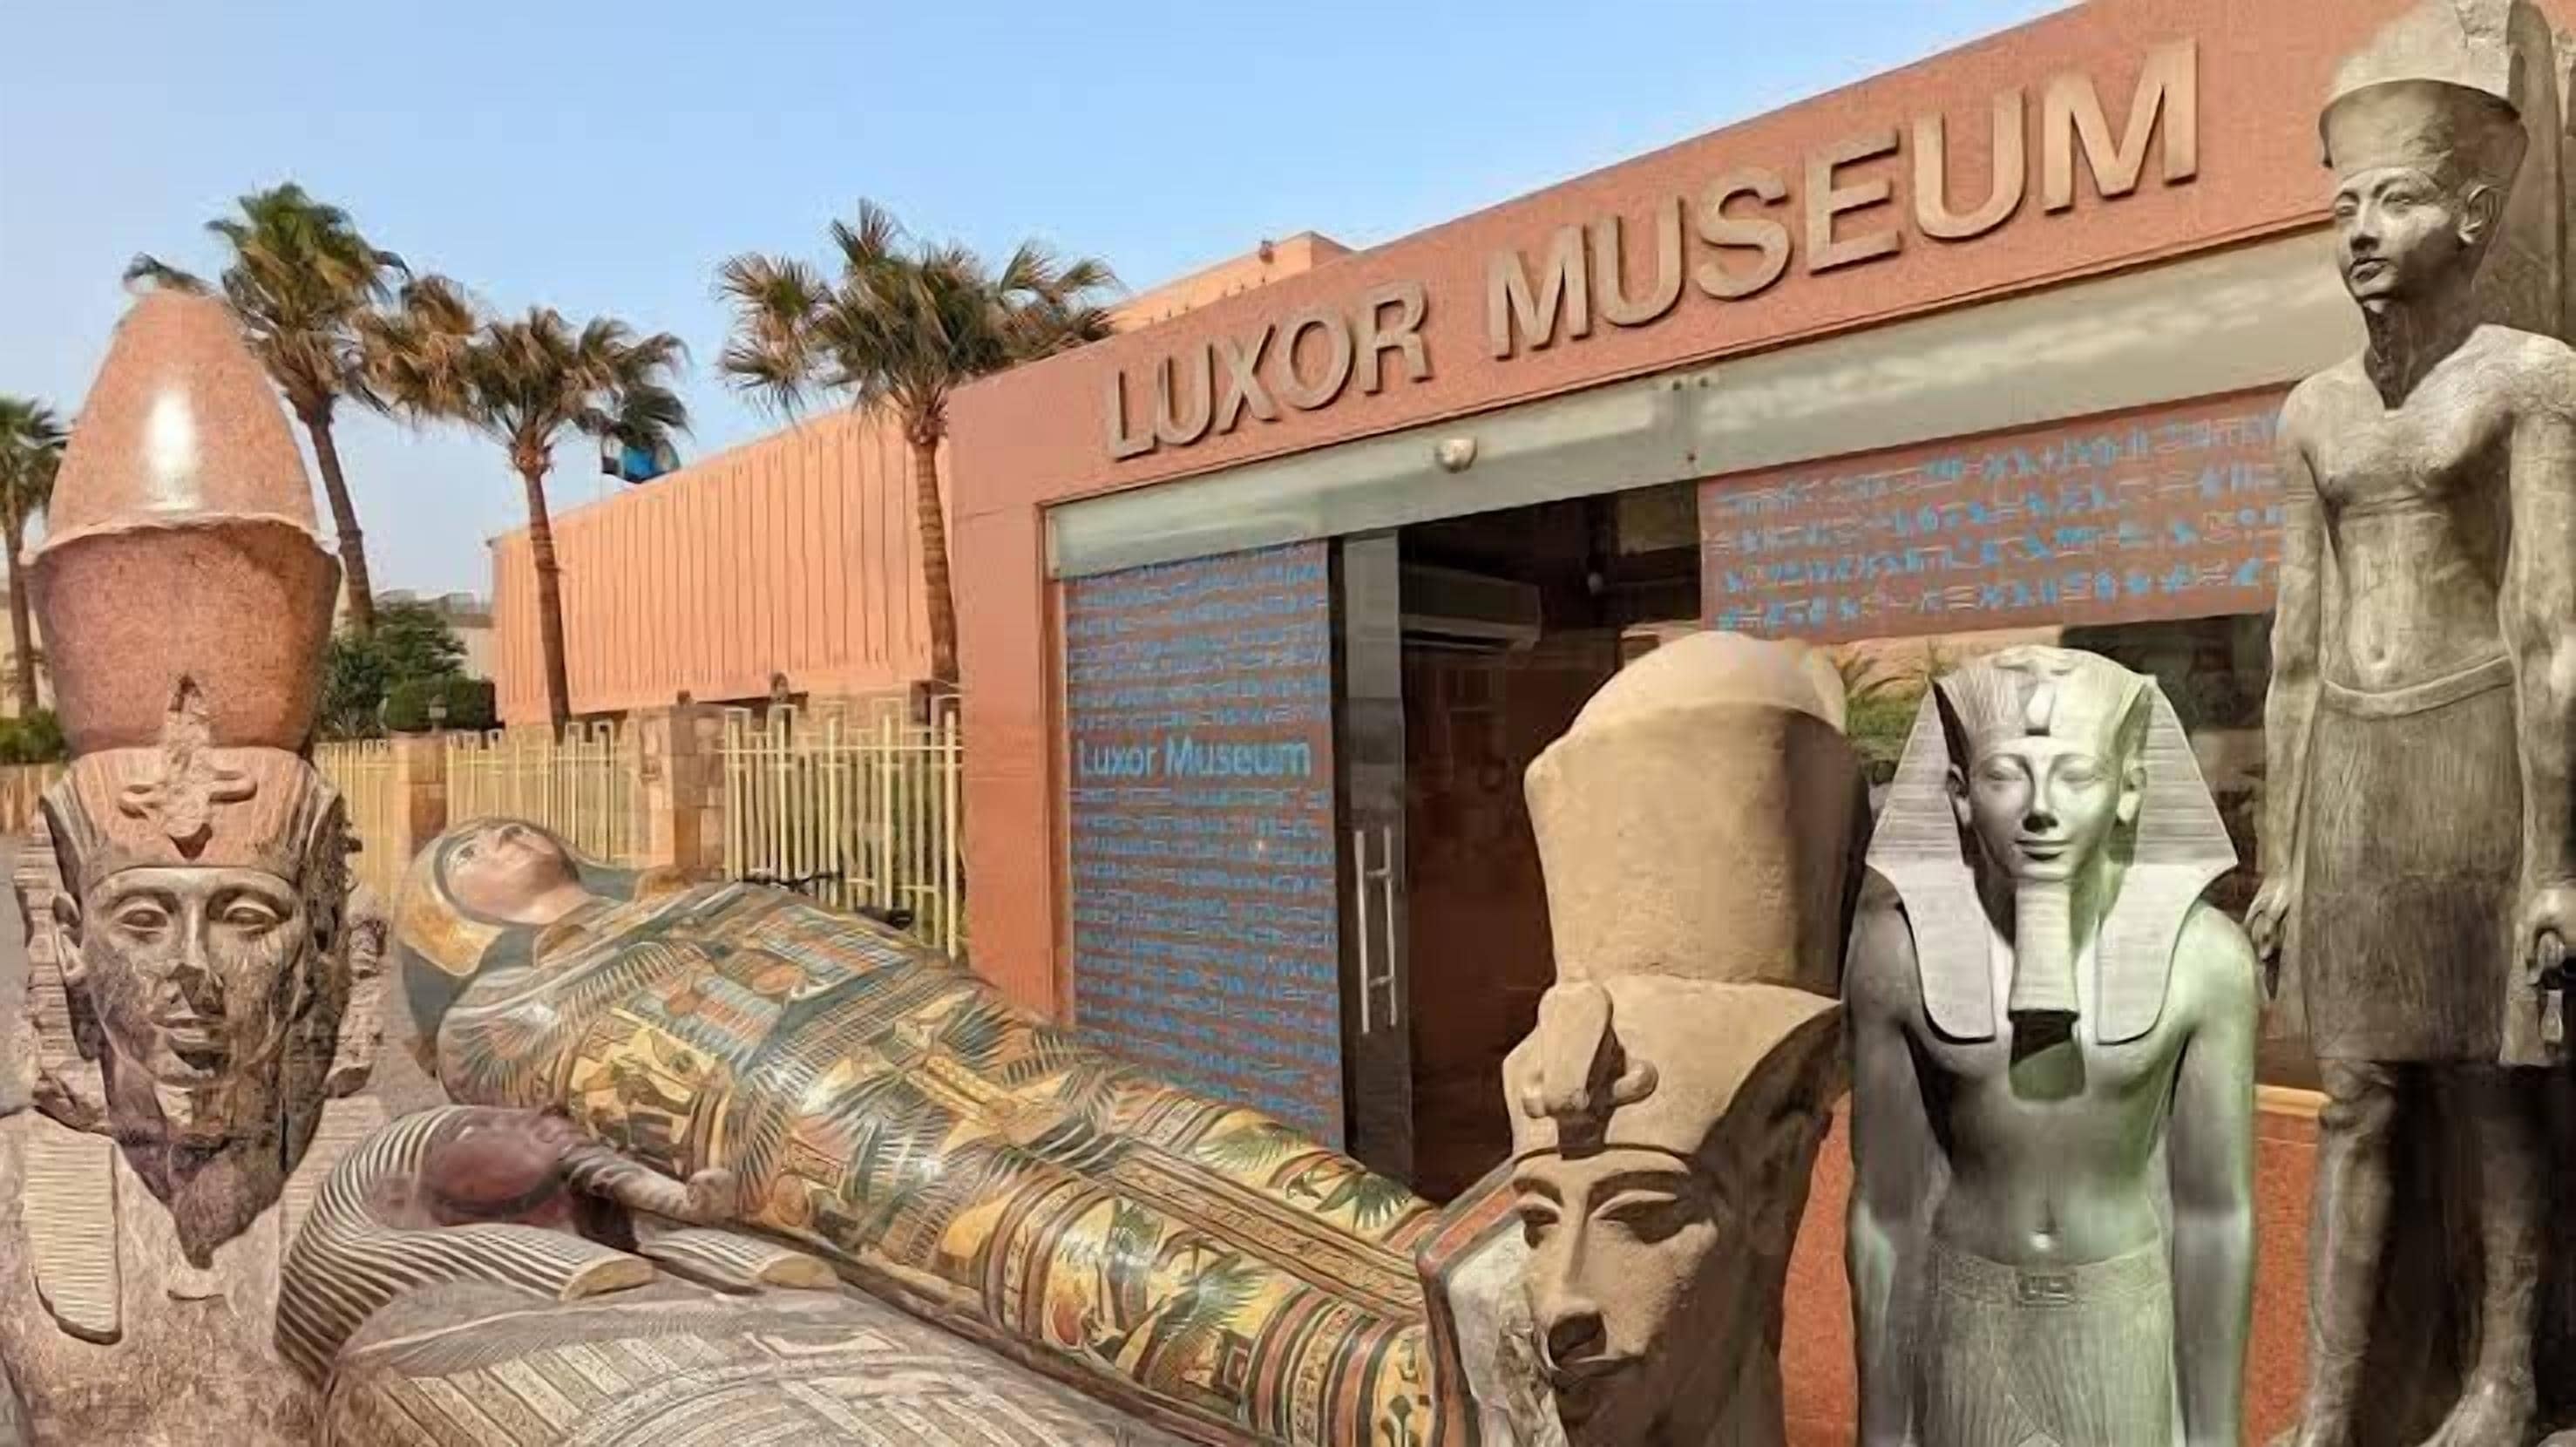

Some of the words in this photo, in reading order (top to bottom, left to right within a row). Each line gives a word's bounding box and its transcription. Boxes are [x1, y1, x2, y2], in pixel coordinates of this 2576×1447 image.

[1107, 281, 1433, 460] LUXOR
[1488, 40, 2200, 360] MUSEUM
[1078, 738, 1156, 778] Luxor
[1166, 736, 1311, 778] Museum
